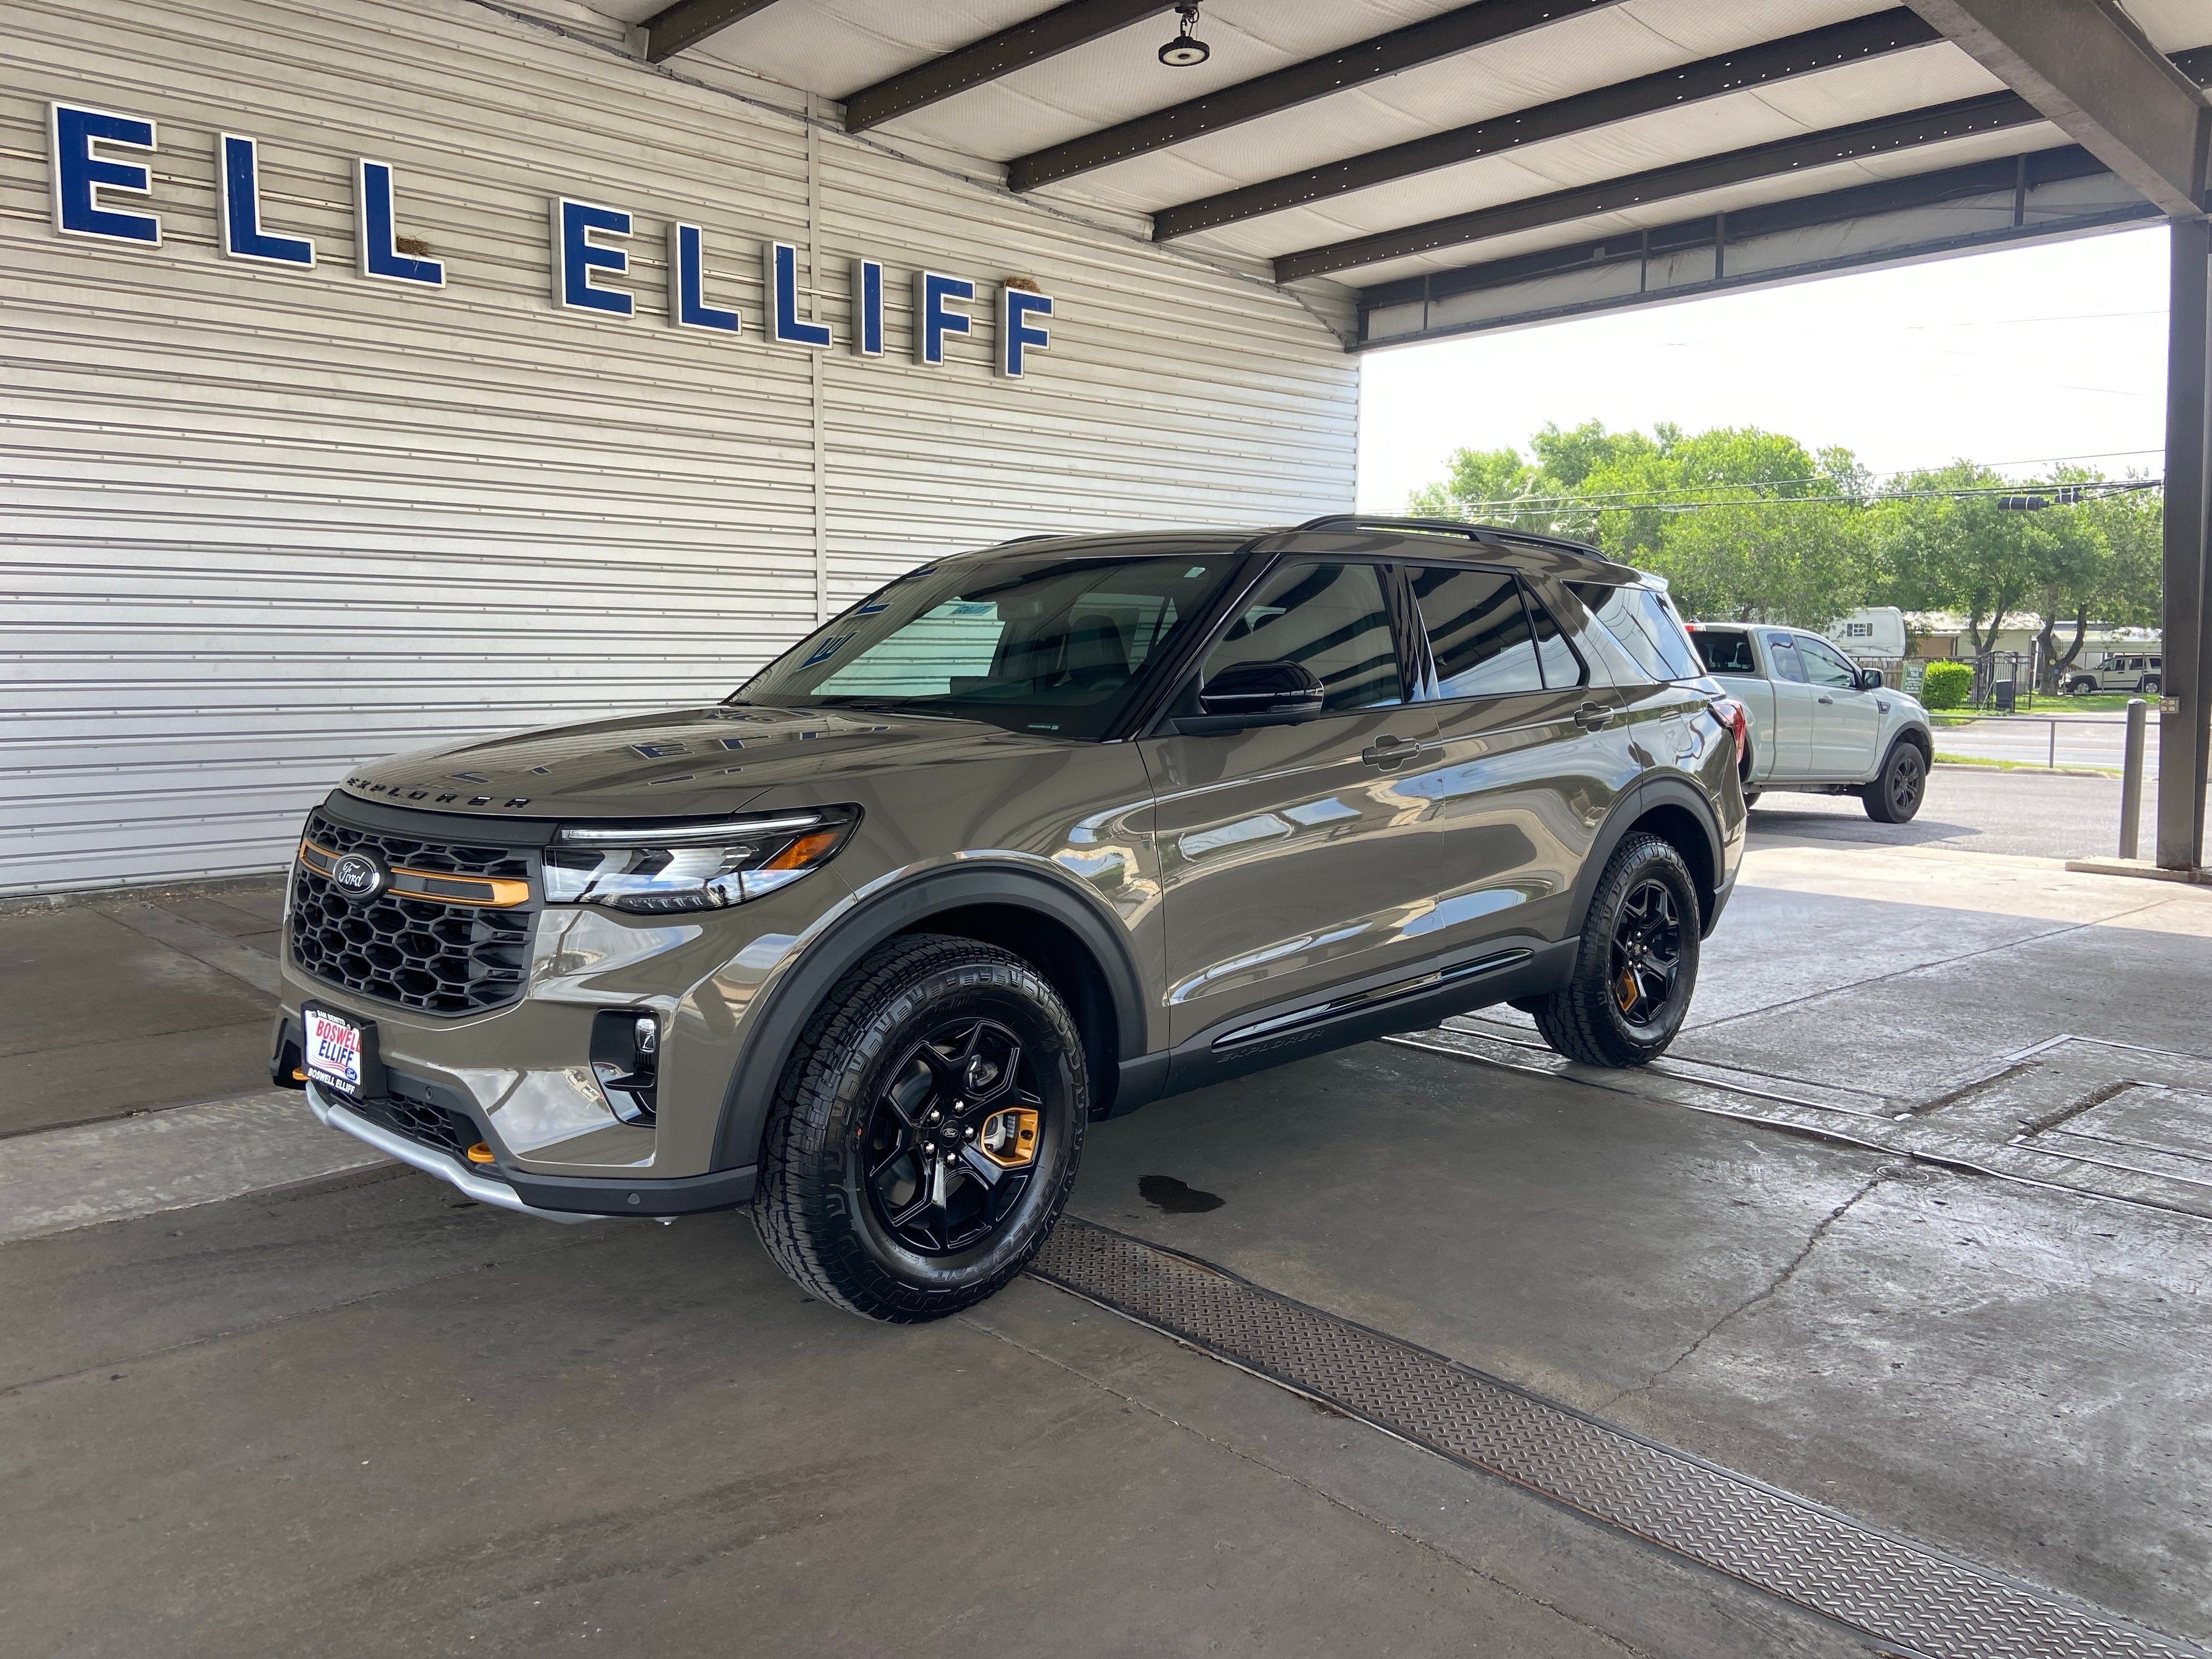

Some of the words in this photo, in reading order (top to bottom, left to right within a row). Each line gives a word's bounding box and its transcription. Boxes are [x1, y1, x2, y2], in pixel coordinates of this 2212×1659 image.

[47, 100, 446, 289] ELL
[551, 195, 1054, 380] ELLIFF
[347, 777, 531, 808] EXPLORER
[338, 861, 366, 887] Ford
[327, 1013, 346, 1026] BENITO
[316, 1019, 360, 1053] BOSWELL
[1217, 1029, 1325, 1063] EXPLORER
[318, 1039, 354, 1067] ELLIFF
[308, 1067, 335, 1086] BOSWELL
[335, 1079, 356, 1094] ELLIFF
[975, 1148, 1065, 1275] DUELER
